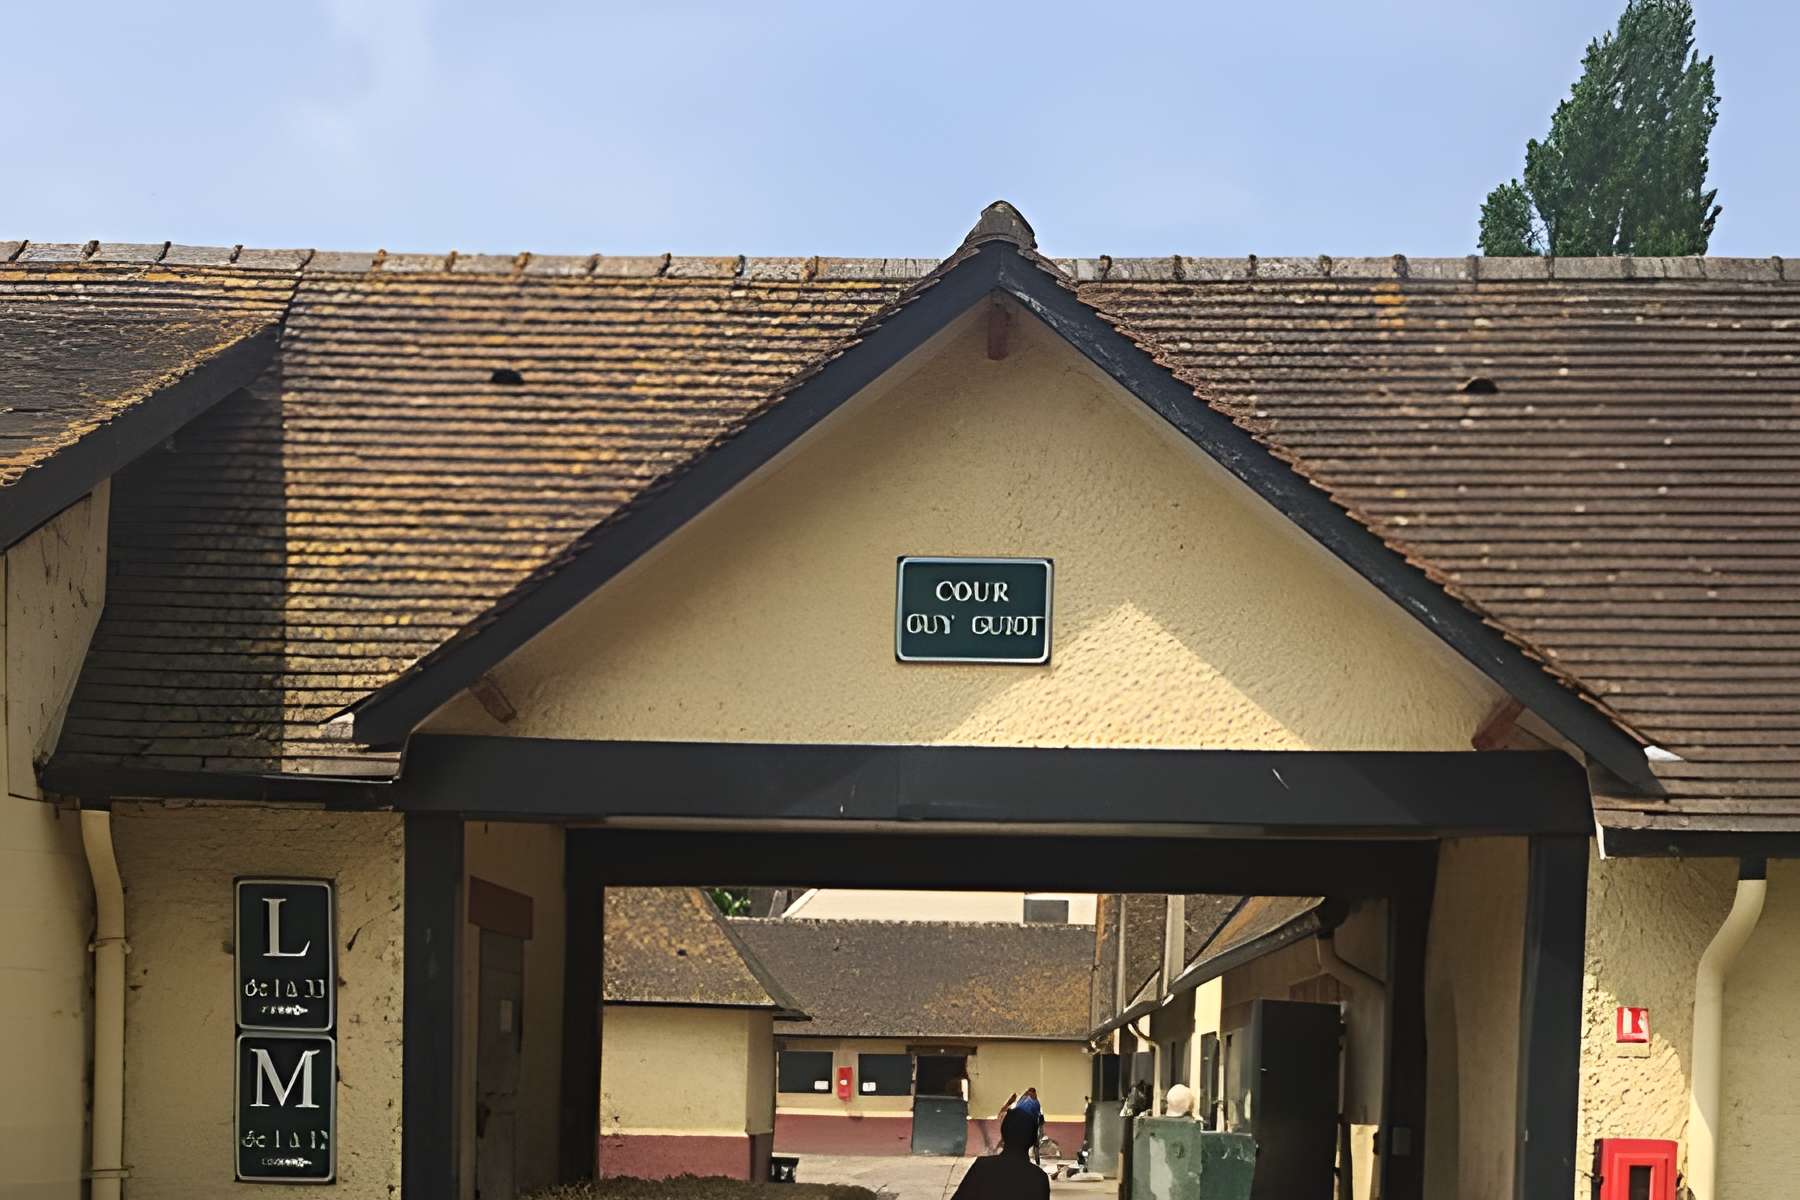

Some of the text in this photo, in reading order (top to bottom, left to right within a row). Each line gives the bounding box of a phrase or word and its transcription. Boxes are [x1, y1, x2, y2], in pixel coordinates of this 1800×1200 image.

[936, 580, 1008, 602] COUR
[262, 897, 311, 957] L
[250, 1048, 320, 1107] M
